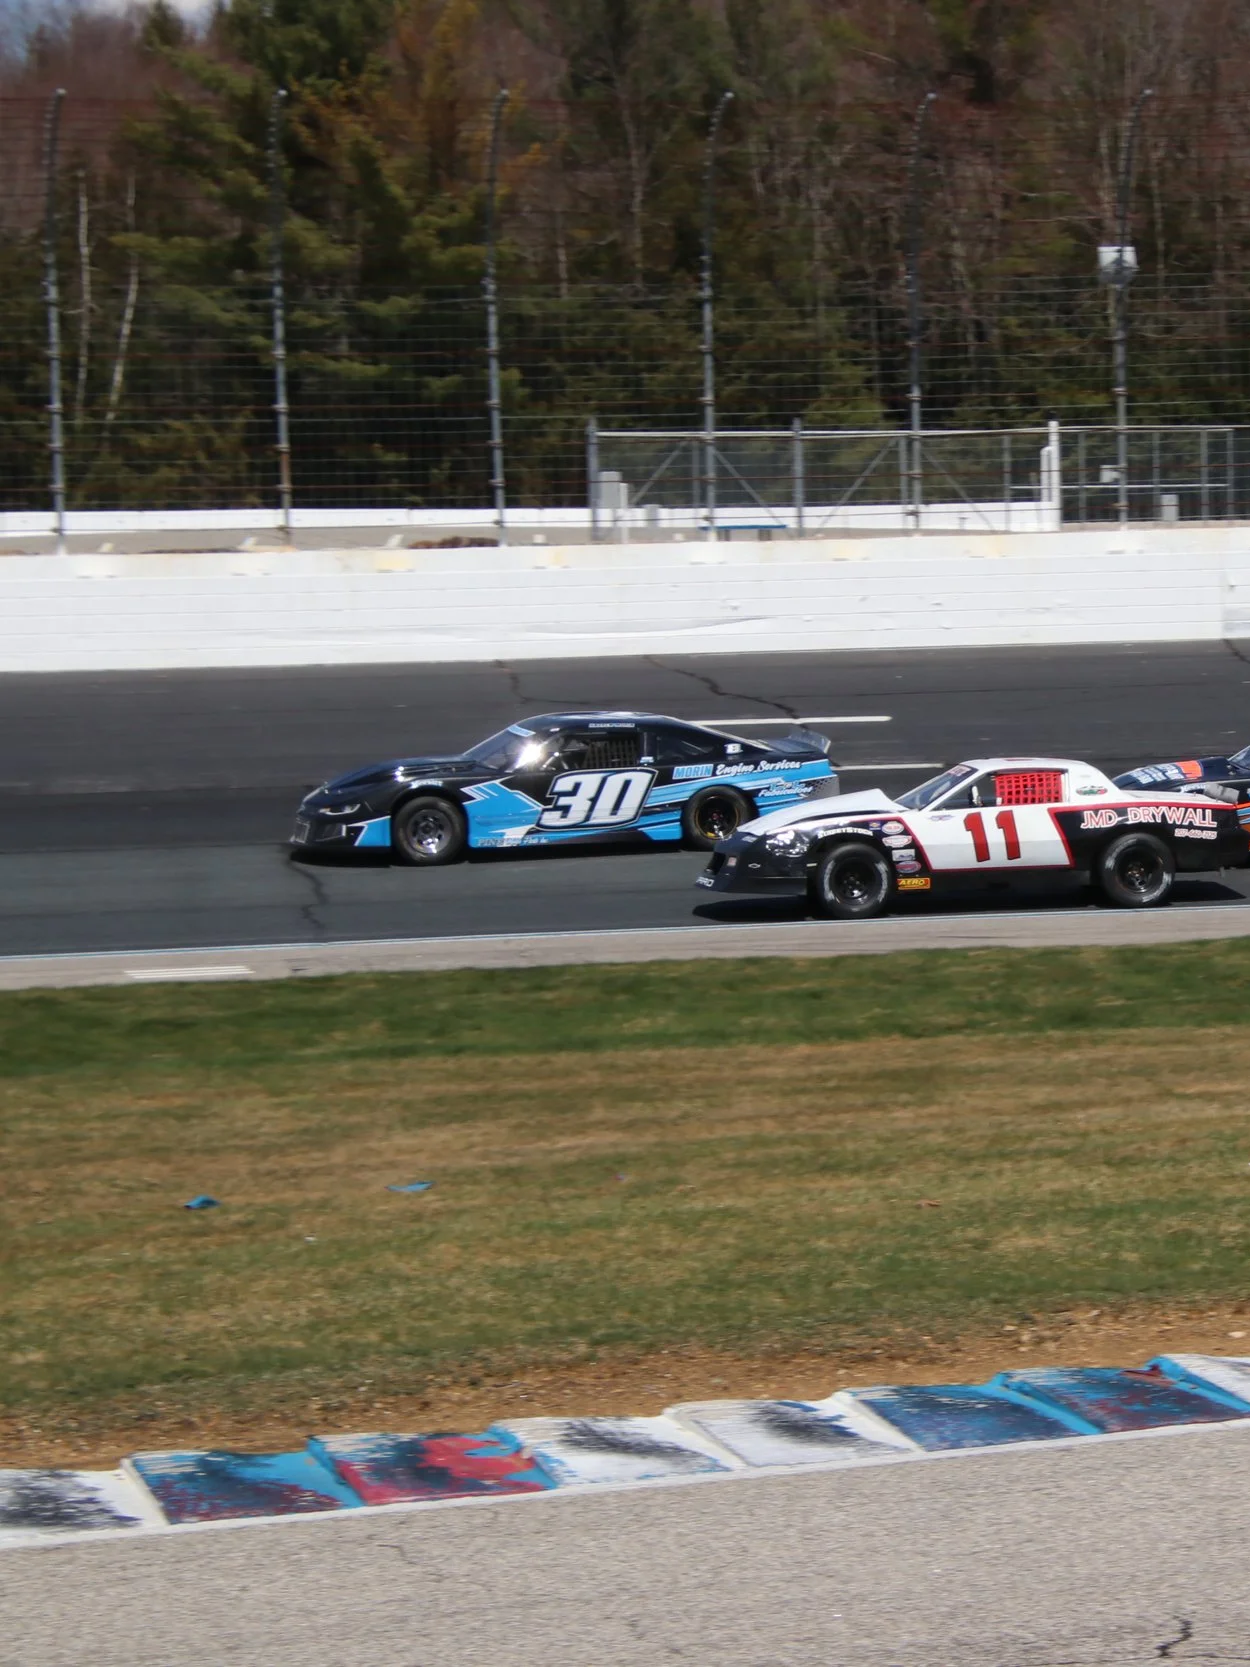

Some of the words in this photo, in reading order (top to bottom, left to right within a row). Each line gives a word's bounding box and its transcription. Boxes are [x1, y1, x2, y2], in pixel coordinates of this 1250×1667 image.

[674, 765, 713, 779] MORIN
[715, 763, 755, 777] Engine
[756, 759, 801, 773] Services
[539, 771, 651, 828] 30
[1080, 808, 1118, 829] JMD
[1127, 806, 1217, 828] DRYWALL
[963, 809, 1022, 863] 11
